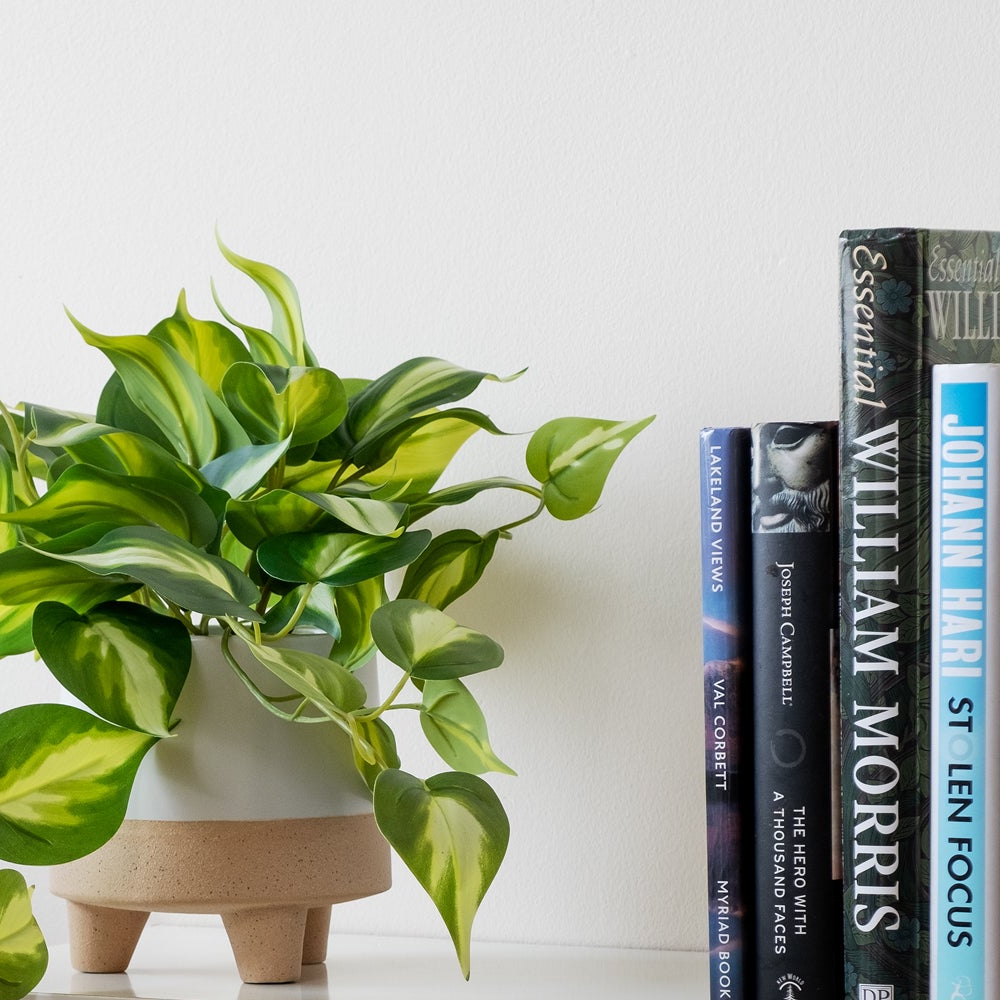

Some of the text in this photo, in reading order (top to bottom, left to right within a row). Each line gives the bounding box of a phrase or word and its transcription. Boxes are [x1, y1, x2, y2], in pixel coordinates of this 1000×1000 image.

[852, 244, 888, 409] Essential
[709, 445, 724, 593] LAKELAND VIEWS
[775, 561, 795, 618] JOSEPH
[940, 413, 985, 678] JOHANN HARI
[712, 679, 727, 791] VAL CORBETT
[852, 420, 901, 933] WILLIAM MORRIS
[772, 791, 786, 955] A THOUSAND FACES
[793, 806, 807, 936] THE HERO WITH
[947, 696, 974, 948] STOLEN FOCUS
[716, 880, 730, 945] MYRIAD
